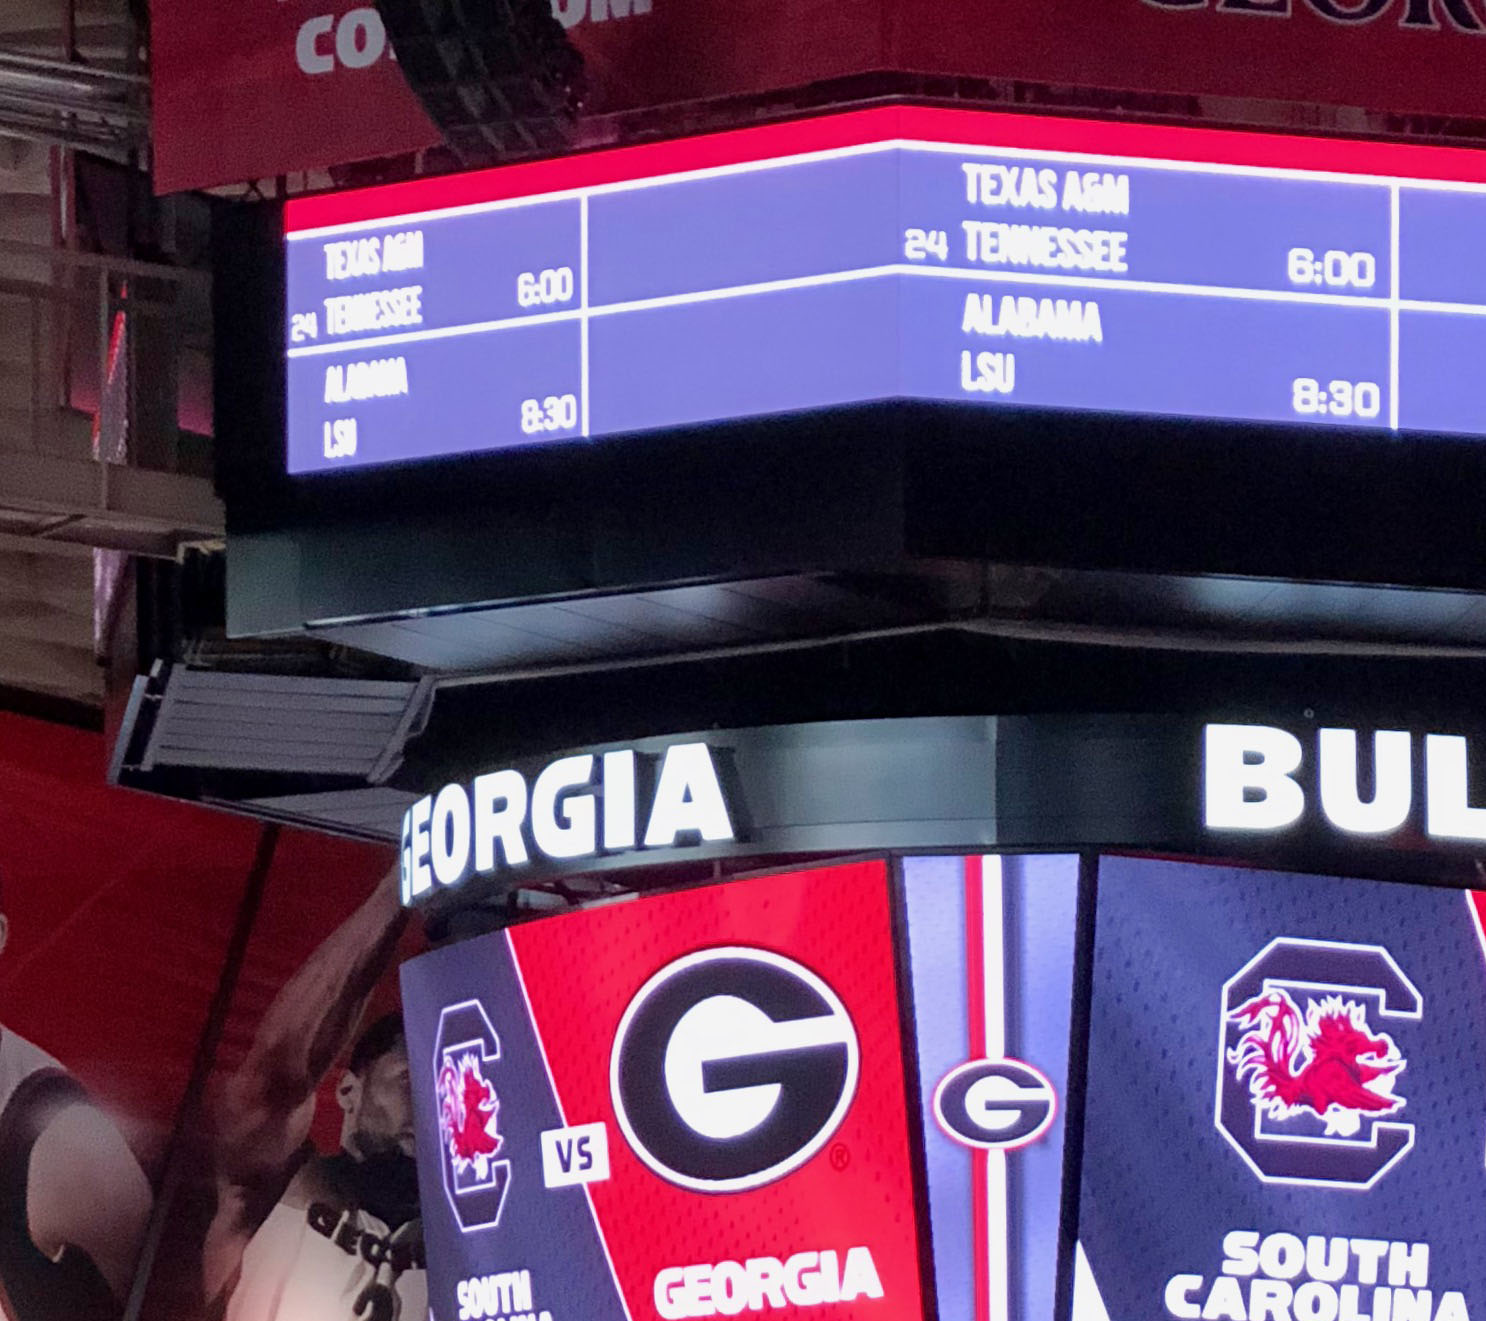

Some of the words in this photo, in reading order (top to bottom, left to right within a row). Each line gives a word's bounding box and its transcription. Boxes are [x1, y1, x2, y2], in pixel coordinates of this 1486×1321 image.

[961, 163, 1057, 209] TEXAS
[1062, 171, 1130, 215] A&M
[324, 236, 381, 280] TEXAS
[904, 229, 948, 261] 24
[961, 220, 1128, 272] TENNESSEE
[1287, 248, 1375, 288] 6:00
[517, 267, 573, 307] 6:00
[291, 312, 318, 341] 24
[324, 285, 423, 335] TENNESSEE
[961, 293, 1102, 342] ALABAMA
[961, 350, 1015, 393] LSU
[521, 394, 577, 434] 8:30
[1292, 378, 1380, 418] 8:30
[324, 418, 357, 458] LSU
[401, 742, 734, 907] GEORGIA
[556, 1135, 593, 1173] VS
[1222, 1230, 1429, 1286] SOUTH
[456, 1270, 533, 1321] SOUTH
[653, 1246, 884, 1320] GEORGIA
